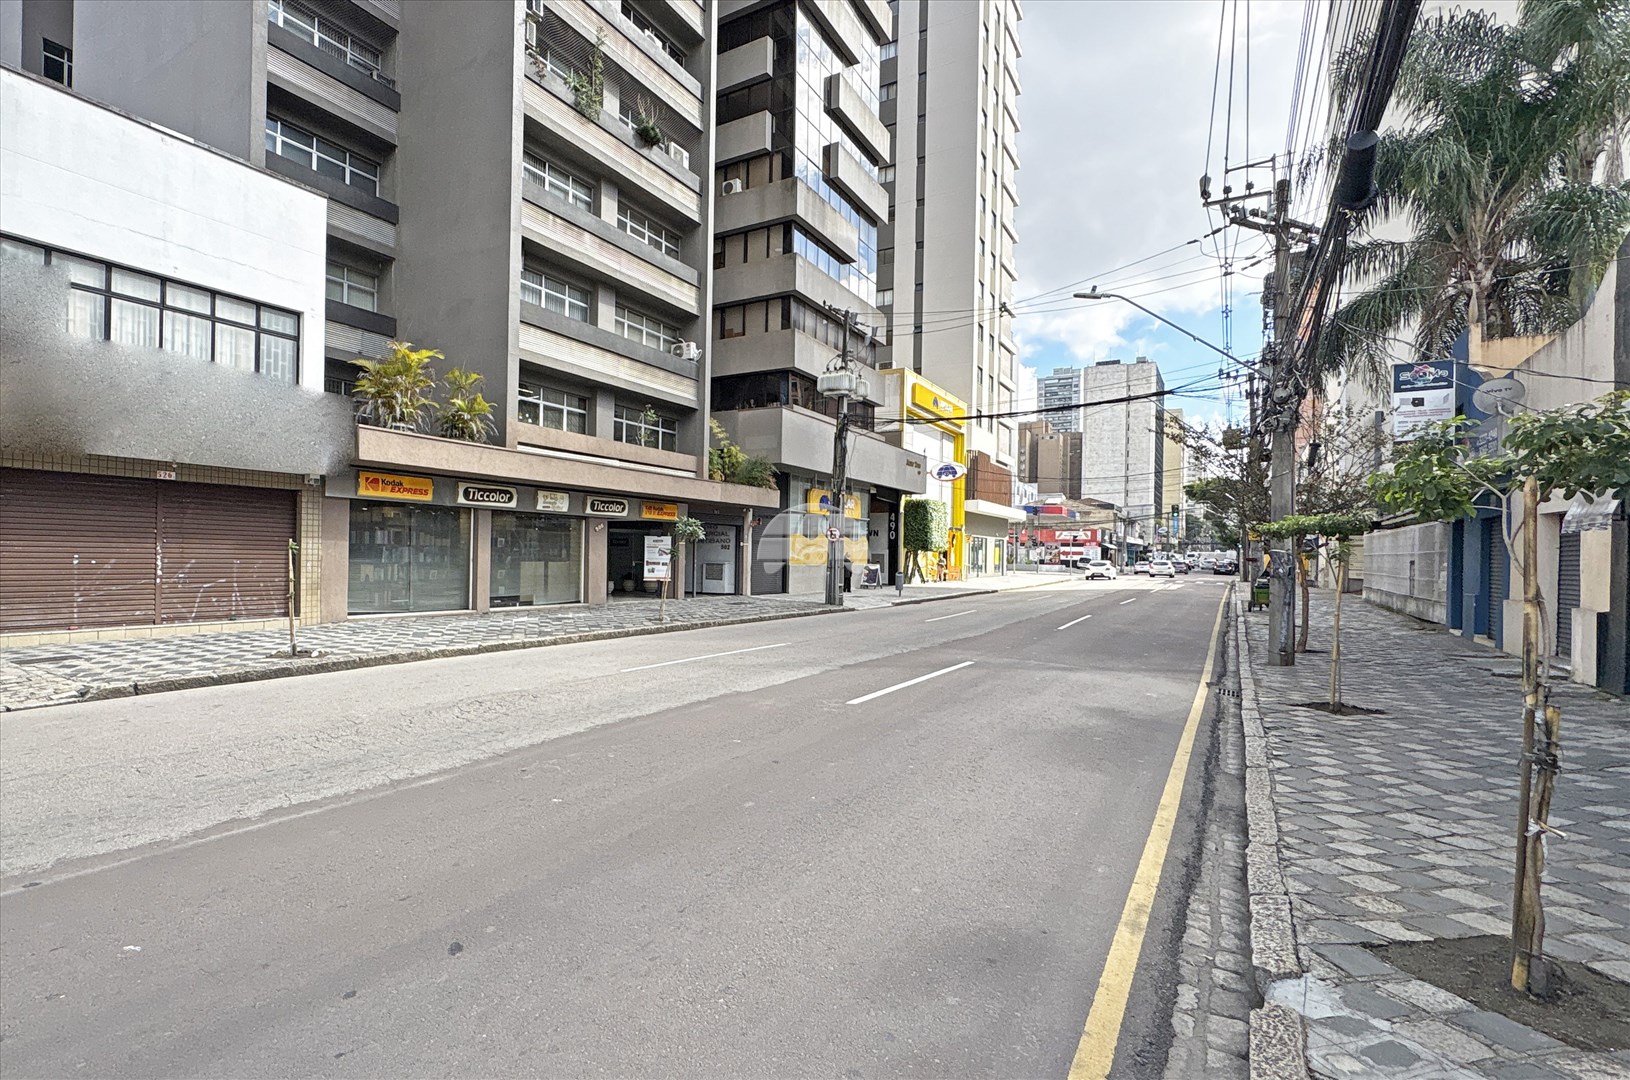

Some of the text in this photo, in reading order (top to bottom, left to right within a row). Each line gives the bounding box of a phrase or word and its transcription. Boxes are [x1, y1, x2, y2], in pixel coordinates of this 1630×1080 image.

[381, 478, 404, 487] Kodak
[390, 486, 429, 496] EXPRESS
[468, 486, 511, 503] Ticcolor
[593, 501, 624, 512] Ticcolor
